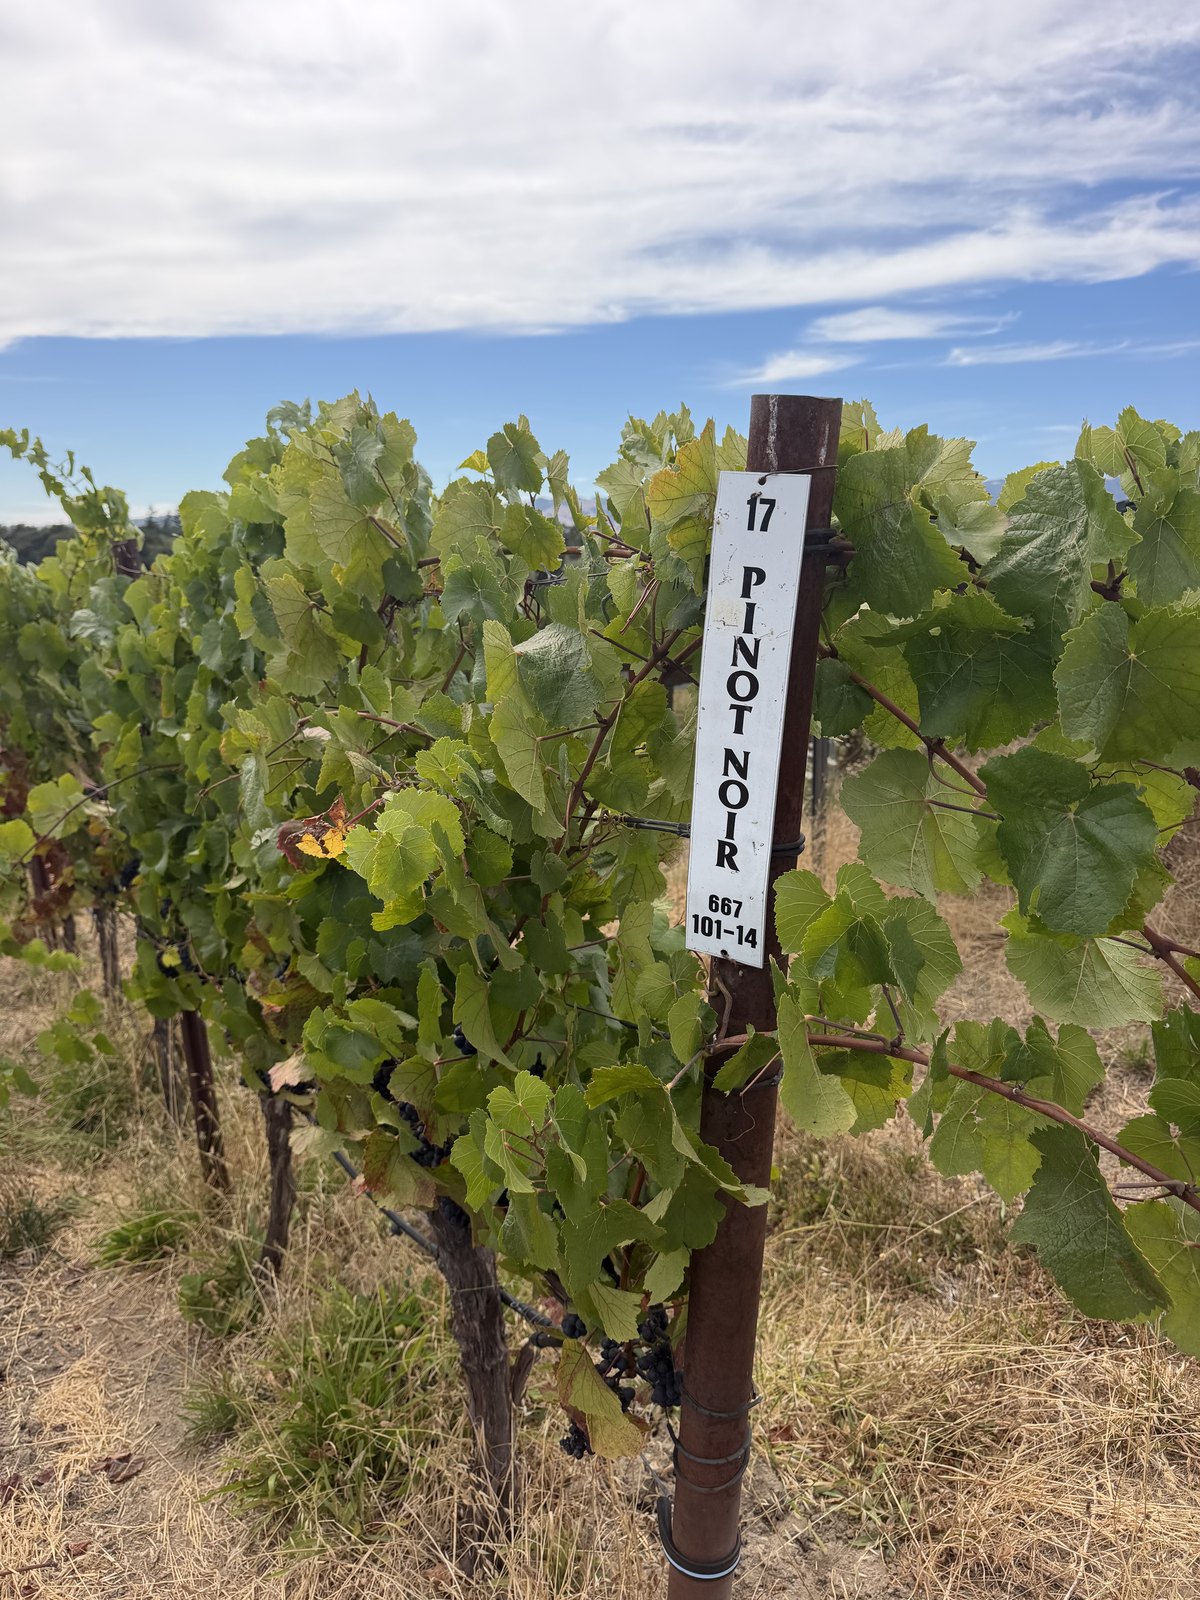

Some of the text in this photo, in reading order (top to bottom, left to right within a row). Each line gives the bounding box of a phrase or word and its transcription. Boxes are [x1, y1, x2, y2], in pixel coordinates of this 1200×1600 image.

[746, 496, 777, 532] 17
[715, 565, 767, 872] PINOT NOIR
[708, 894, 743, 918] 667
[692, 913, 758, 949] 101-14
